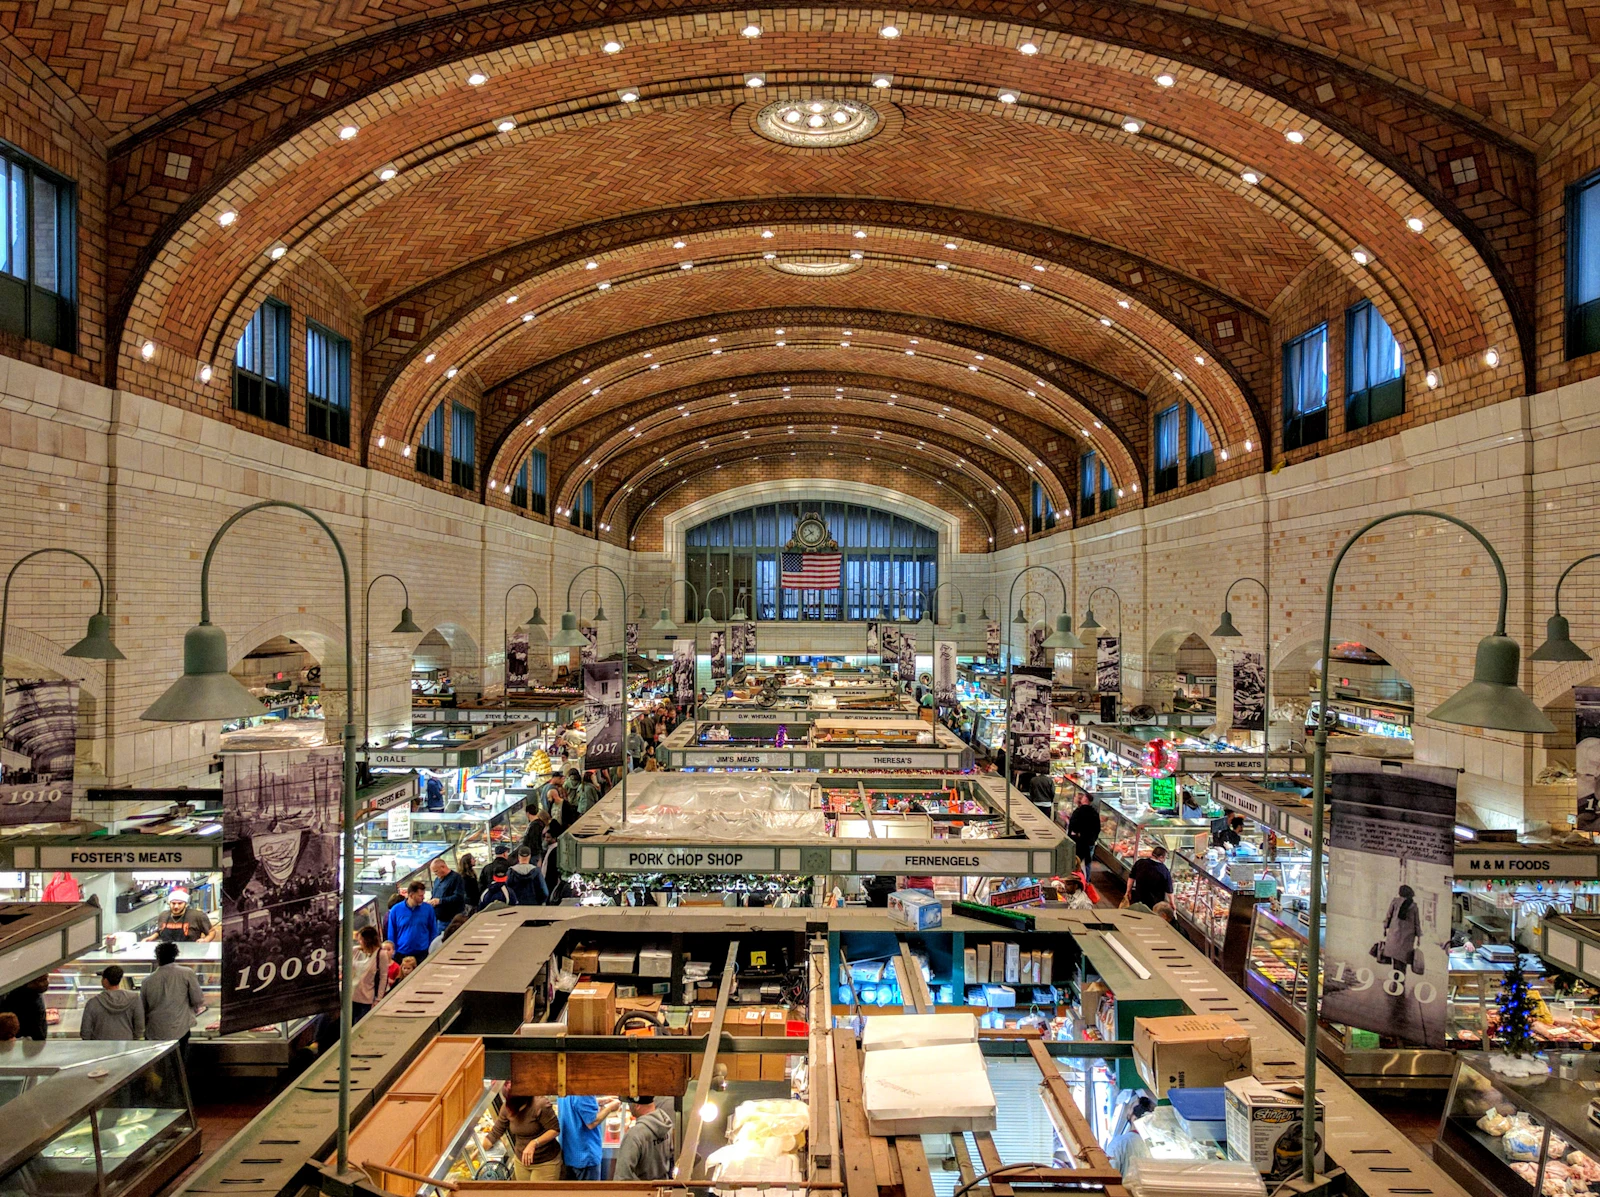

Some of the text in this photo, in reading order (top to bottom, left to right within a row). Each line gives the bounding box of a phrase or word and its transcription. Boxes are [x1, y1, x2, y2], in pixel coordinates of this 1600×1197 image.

[591, 742, 617, 755] 1917
[8, 789, 62, 807] 1910
[71, 852, 182, 863] FOSTER'S MEATS
[629, 853, 743, 866] PORK CHOP SHOP
[905, 857, 979, 866] FERNENGELS
[1470, 860, 1550, 870] M & M FOODS
[234, 948, 328, 992] 1908
[1331, 961, 1437, 1004] 1980
